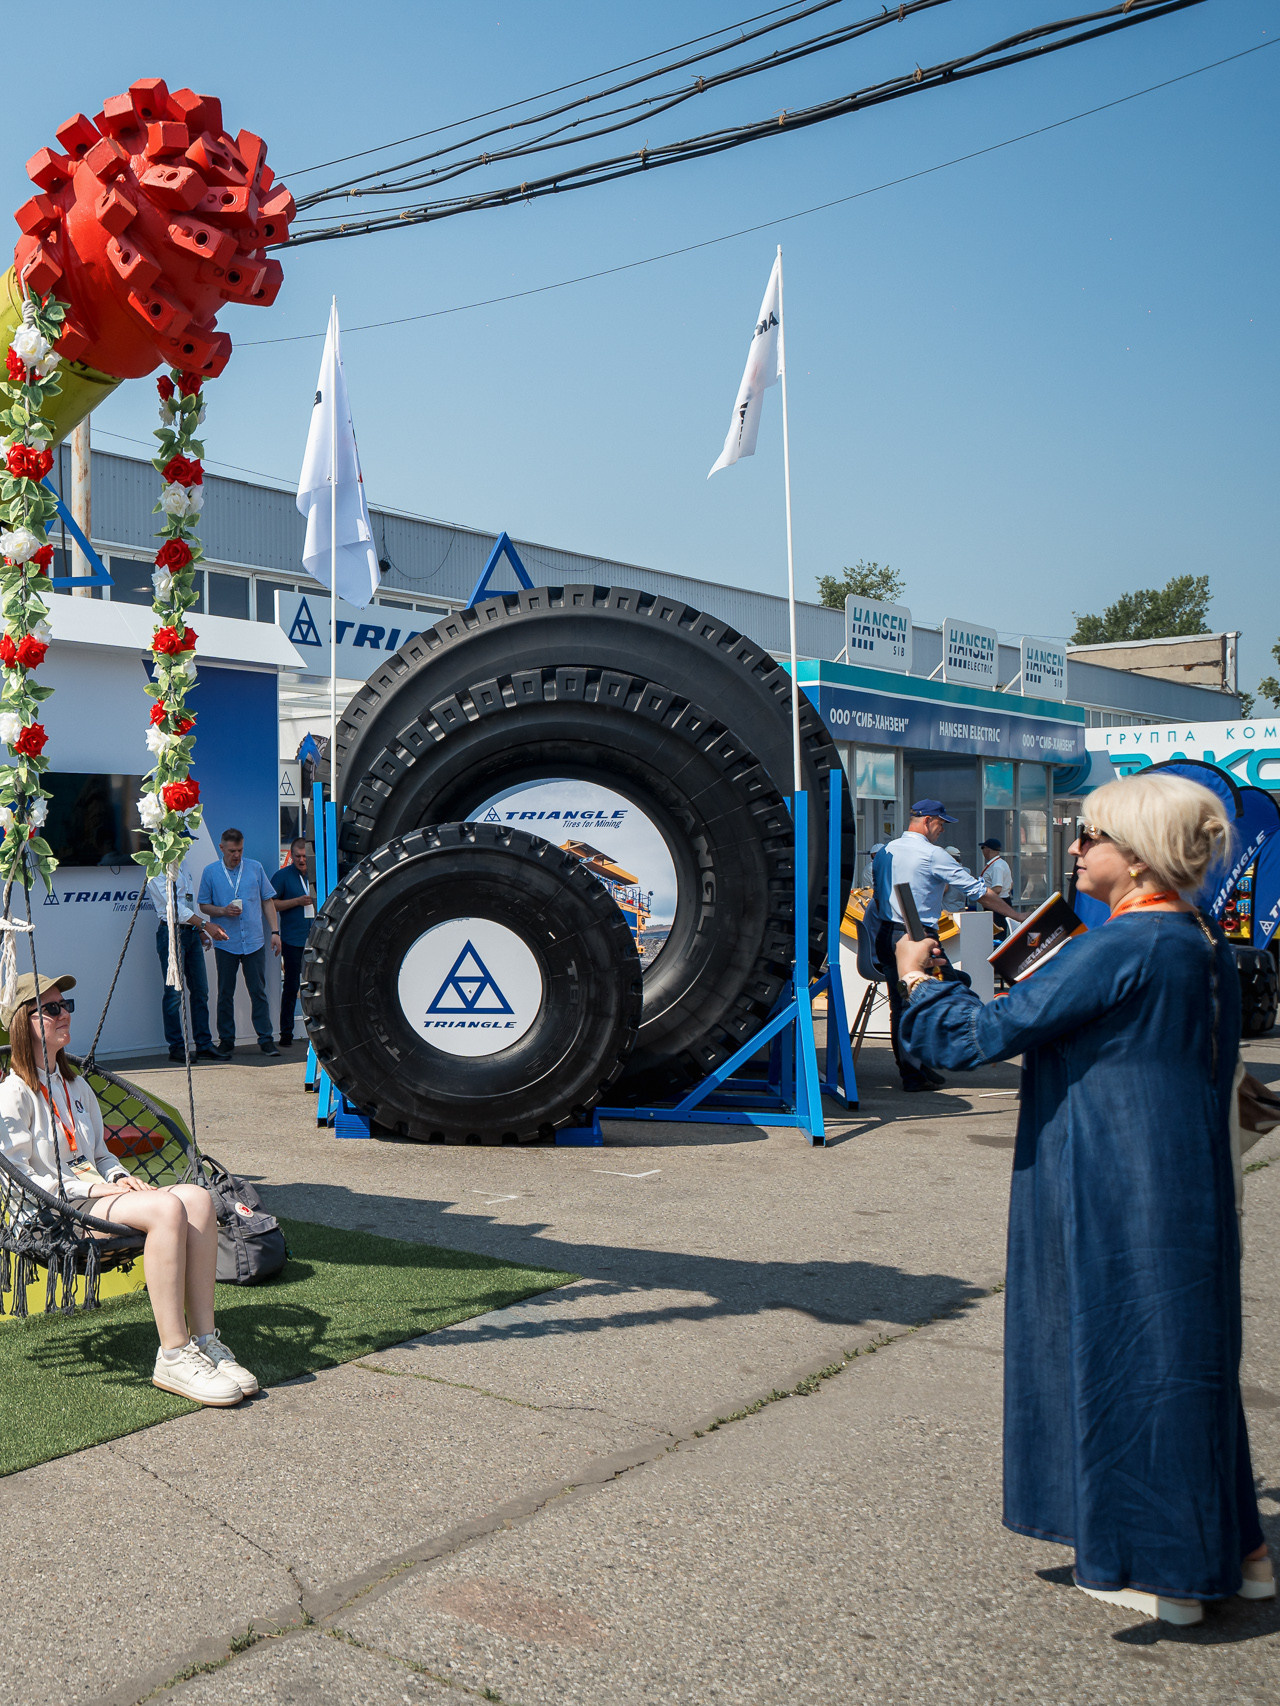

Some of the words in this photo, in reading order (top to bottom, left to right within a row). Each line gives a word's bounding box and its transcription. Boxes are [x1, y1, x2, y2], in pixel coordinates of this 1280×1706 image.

[852, 606, 908, 644] HANSEN
[892, 645, 906, 657] SIB
[949, 628, 996, 662] HANSEN
[967, 660, 994, 675] ELECTRIC
[1026, 647, 1065, 678] HANSEN
[829, 707, 851, 726] ООО
[851, 710, 910, 733] "СИБ-ХАНЗЕН"
[939, 720, 969, 739] HANSEN
[970, 724, 1001, 743] ELECTRIC
[1105, 729, 1196, 746] ГРУППА
[1226, 725, 1278, 740] КОМ
[1022, 733, 1035, 748] ООО
[505, 809, 628, 820] TRIANGLE
[562, 820, 581, 828] Tires
[581, 820, 594, 828] for
[594, 819, 623, 829] Mining
[62, 890, 151, 903] TRIANGL
[112, 902, 128, 912] Tires
[128, 902, 138, 912] fo
[423, 1020, 518, 1029] TRIANGLE
